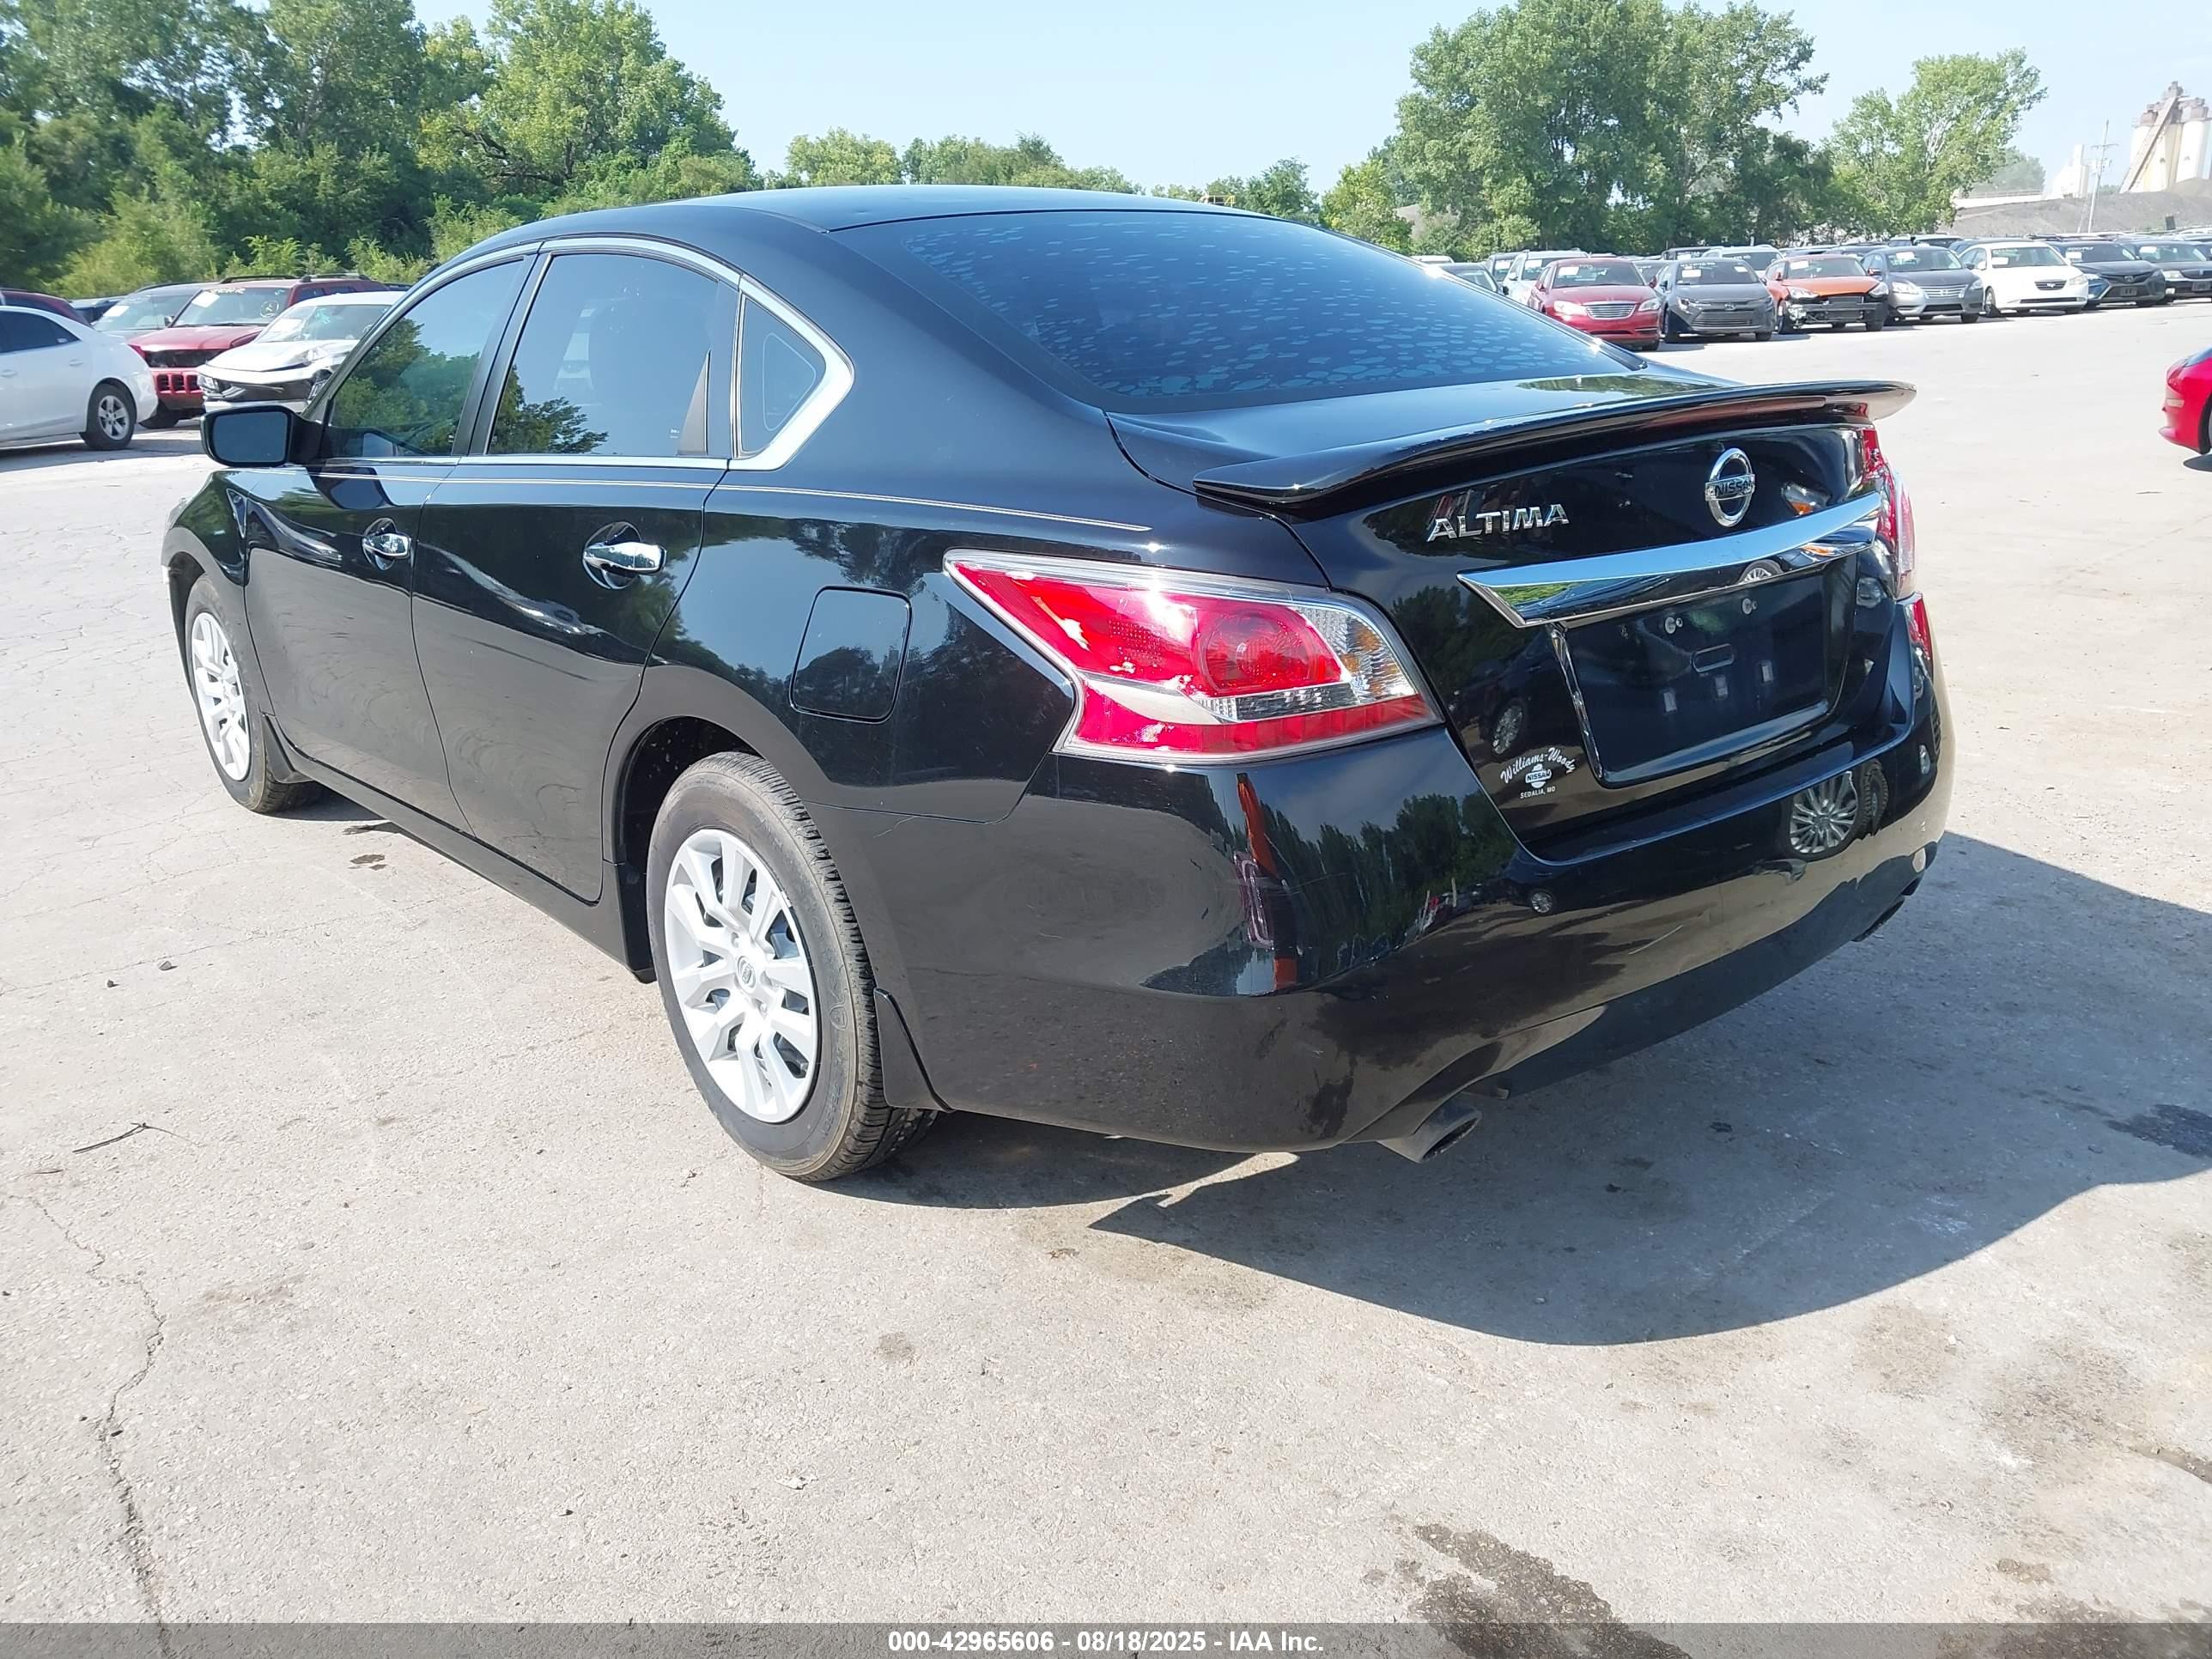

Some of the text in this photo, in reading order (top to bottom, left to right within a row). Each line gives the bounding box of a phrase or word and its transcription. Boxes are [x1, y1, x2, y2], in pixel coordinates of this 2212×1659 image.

[1426, 503, 1570, 542] ALTIMA
[1527, 770, 1551, 781] NISSAN
[1520, 788, 1546, 799] SEDALIA,
